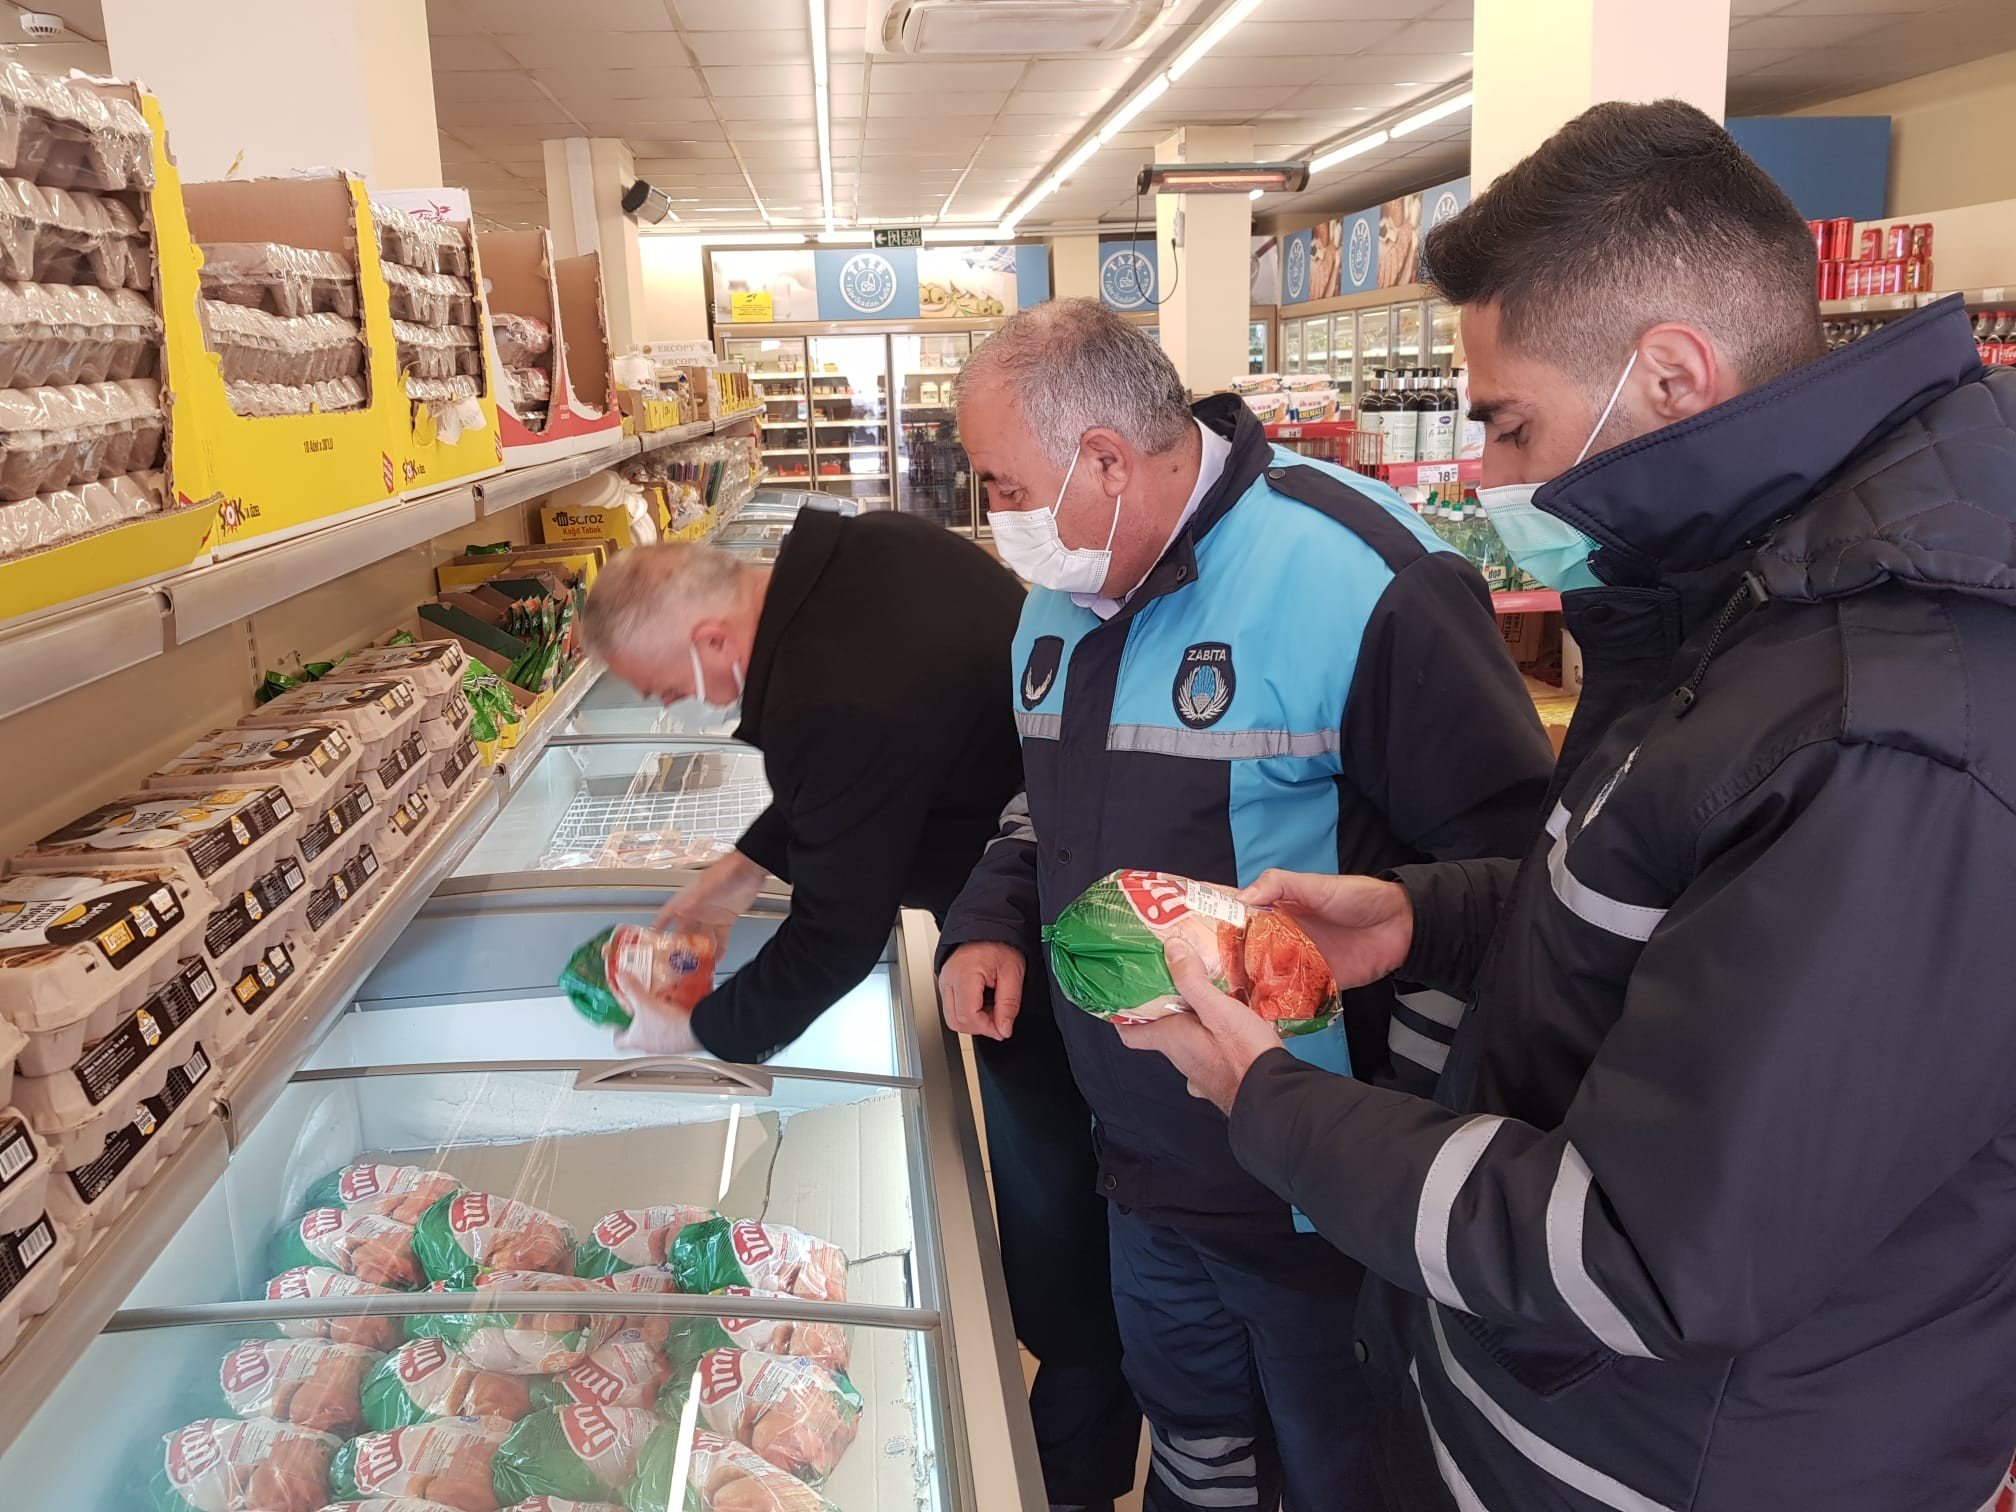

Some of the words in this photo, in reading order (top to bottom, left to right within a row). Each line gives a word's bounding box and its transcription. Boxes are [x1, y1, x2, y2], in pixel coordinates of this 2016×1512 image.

[901, 229, 920, 238] EXIT
[847, 257, 886, 275] TAZE
[1108, 255, 1145, 271] TAZE
[1438, 471, 1451, 482] 18
[1186, 648, 1227, 662] ZABITA
